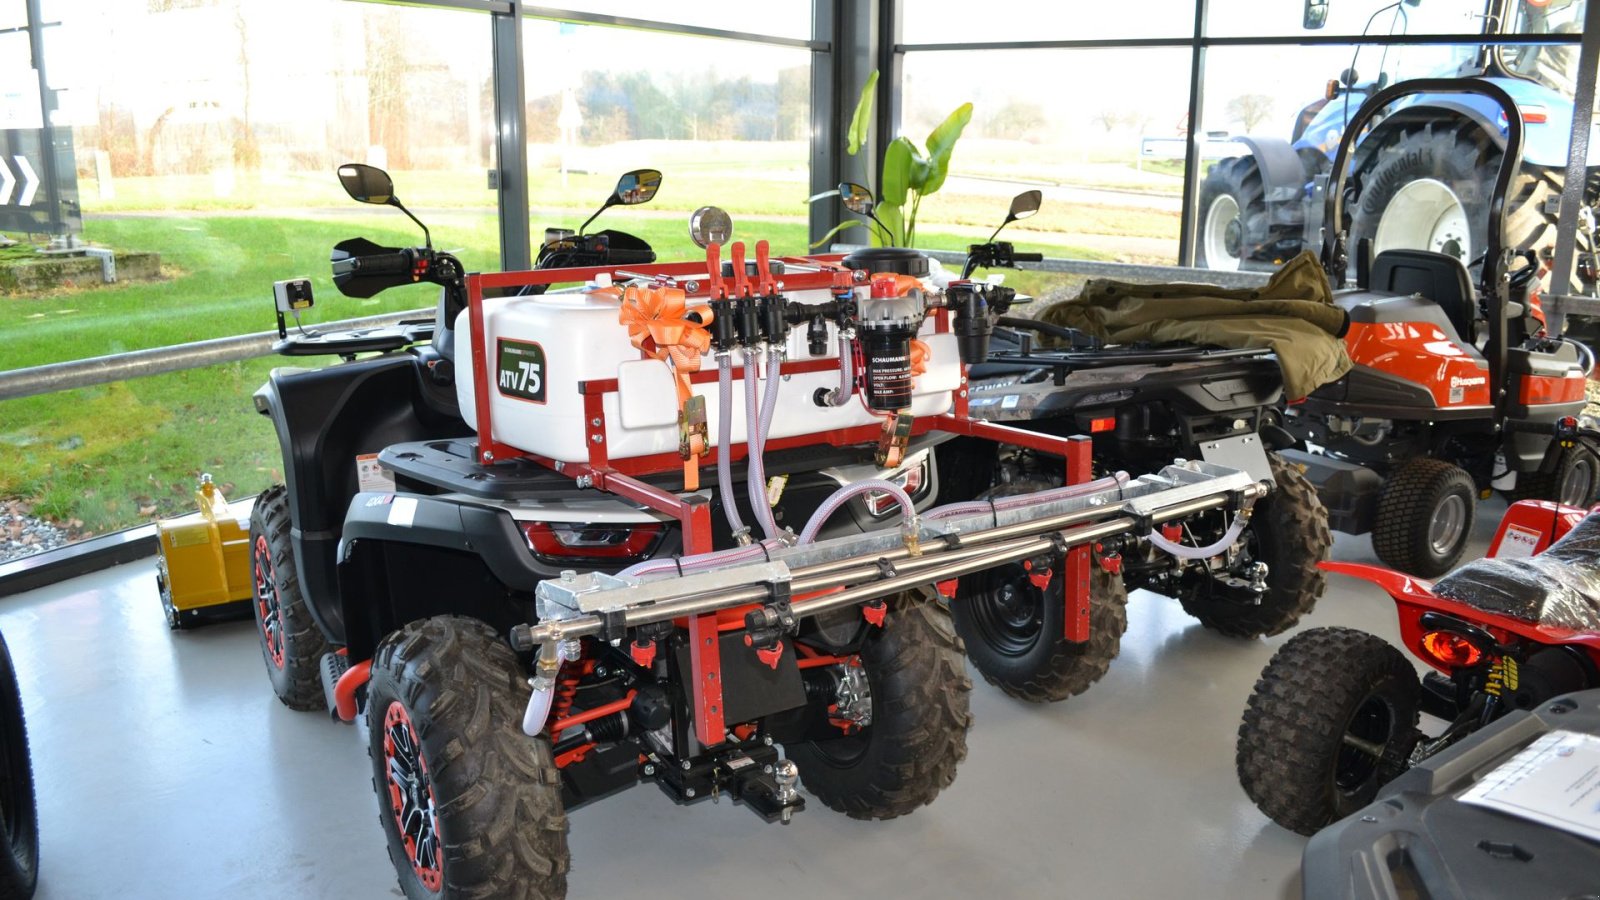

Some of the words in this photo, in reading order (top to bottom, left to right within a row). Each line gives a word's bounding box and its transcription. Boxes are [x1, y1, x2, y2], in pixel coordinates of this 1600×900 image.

[1363, 147, 1422, 214] Continental
[499, 369, 519, 389] ATV
[518, 361, 541, 393] 75
